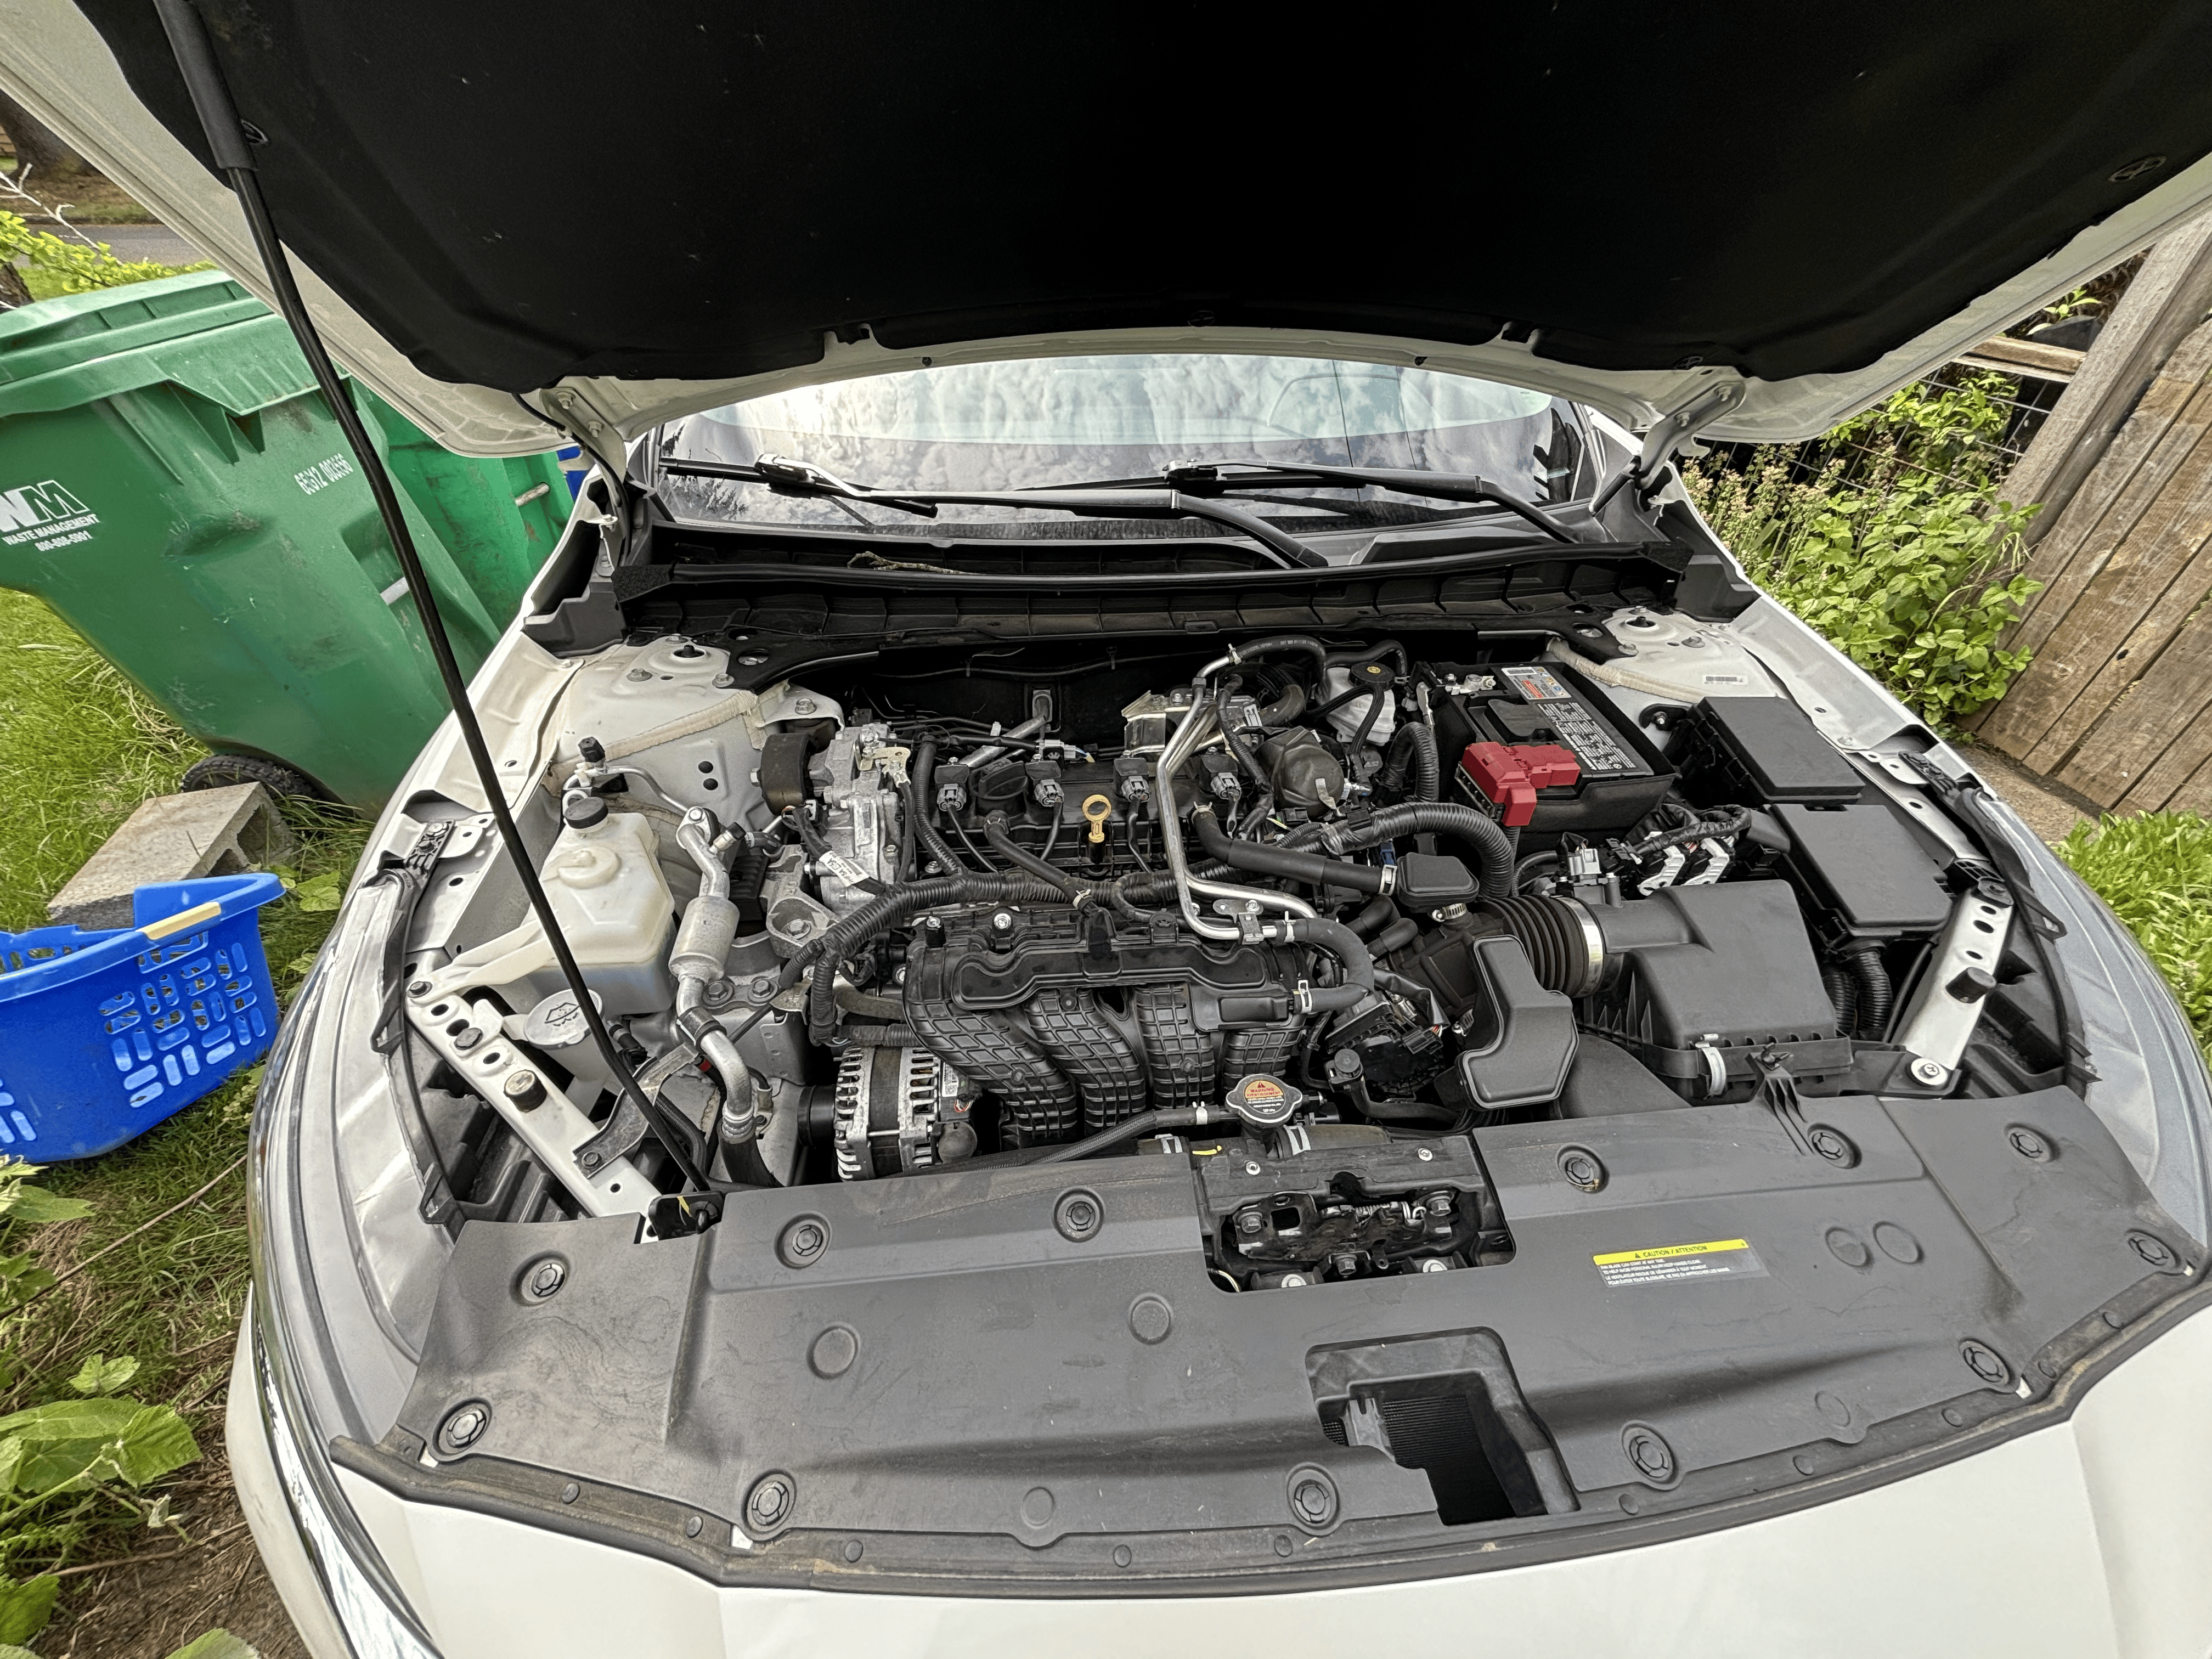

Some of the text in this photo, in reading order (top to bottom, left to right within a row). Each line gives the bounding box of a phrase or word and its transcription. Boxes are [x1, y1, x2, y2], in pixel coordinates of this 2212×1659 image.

[1, 514, 101, 545] WASTE MANAGEMENT
[1675, 1245, 1707, 1254] ATTENTION
